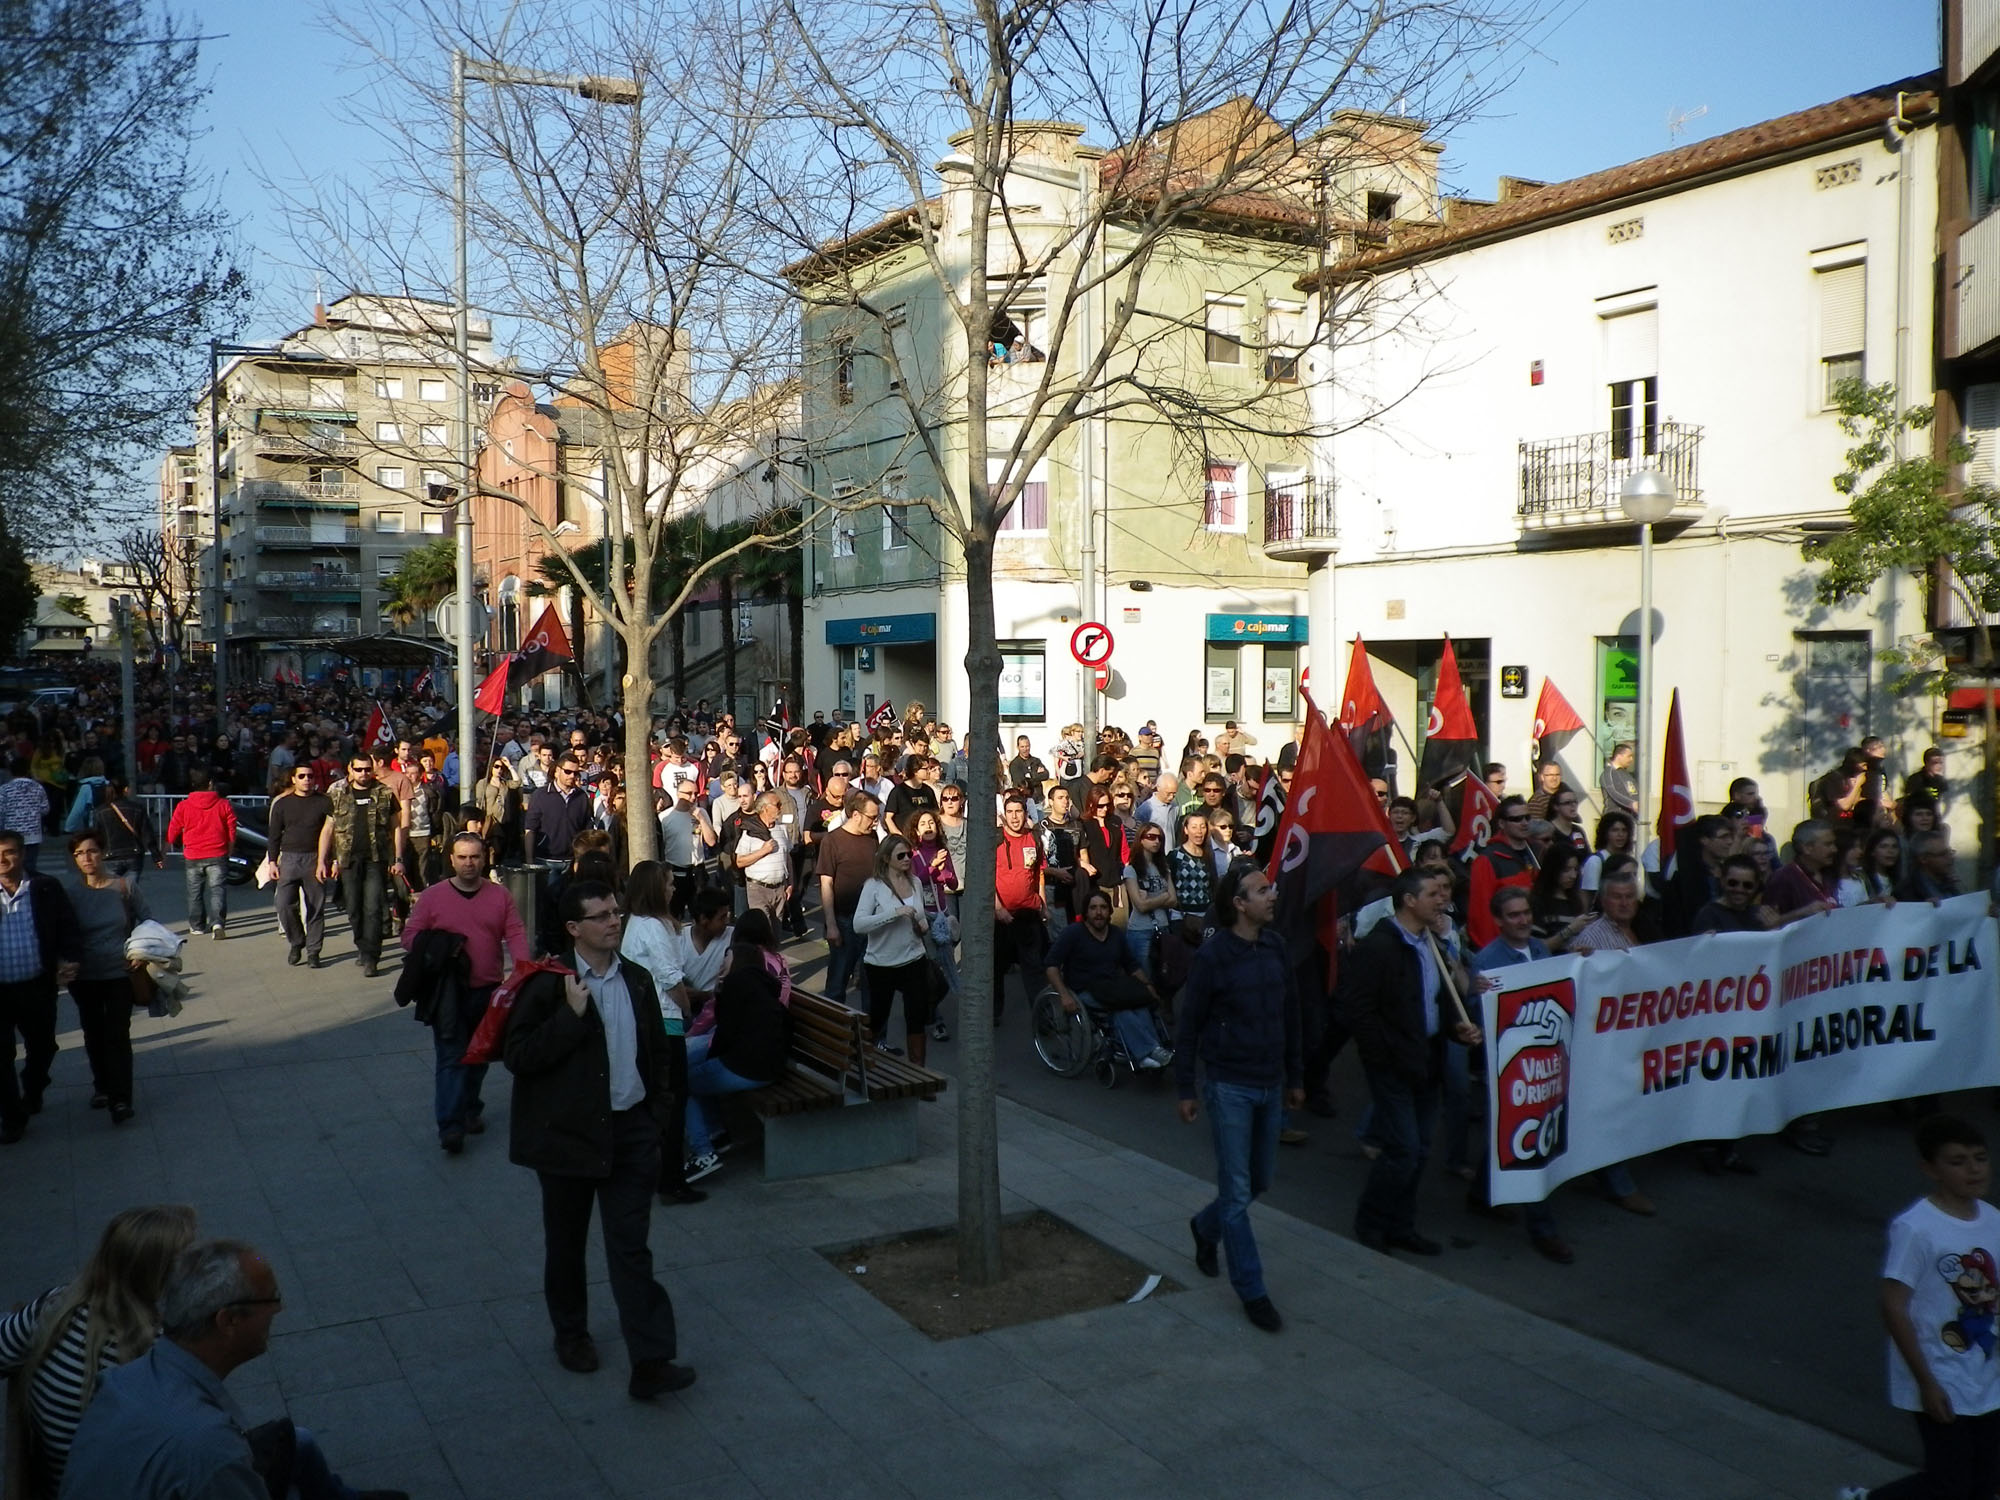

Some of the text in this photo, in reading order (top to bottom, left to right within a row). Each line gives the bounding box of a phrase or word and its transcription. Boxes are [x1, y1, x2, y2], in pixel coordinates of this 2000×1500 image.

[868, 624, 892, 635] cajamar
[1247, 620, 1289, 635] cajamar
[870, 706, 892, 729] CGT
[1595, 964, 1772, 1034] DEROGACIÓ
[1903, 944, 1941, 982] DE
[1947, 937, 1982, 975] LA
[1794, 1002, 1936, 1063] LABORAL
[1512, 1104, 1564, 1161] CGT
